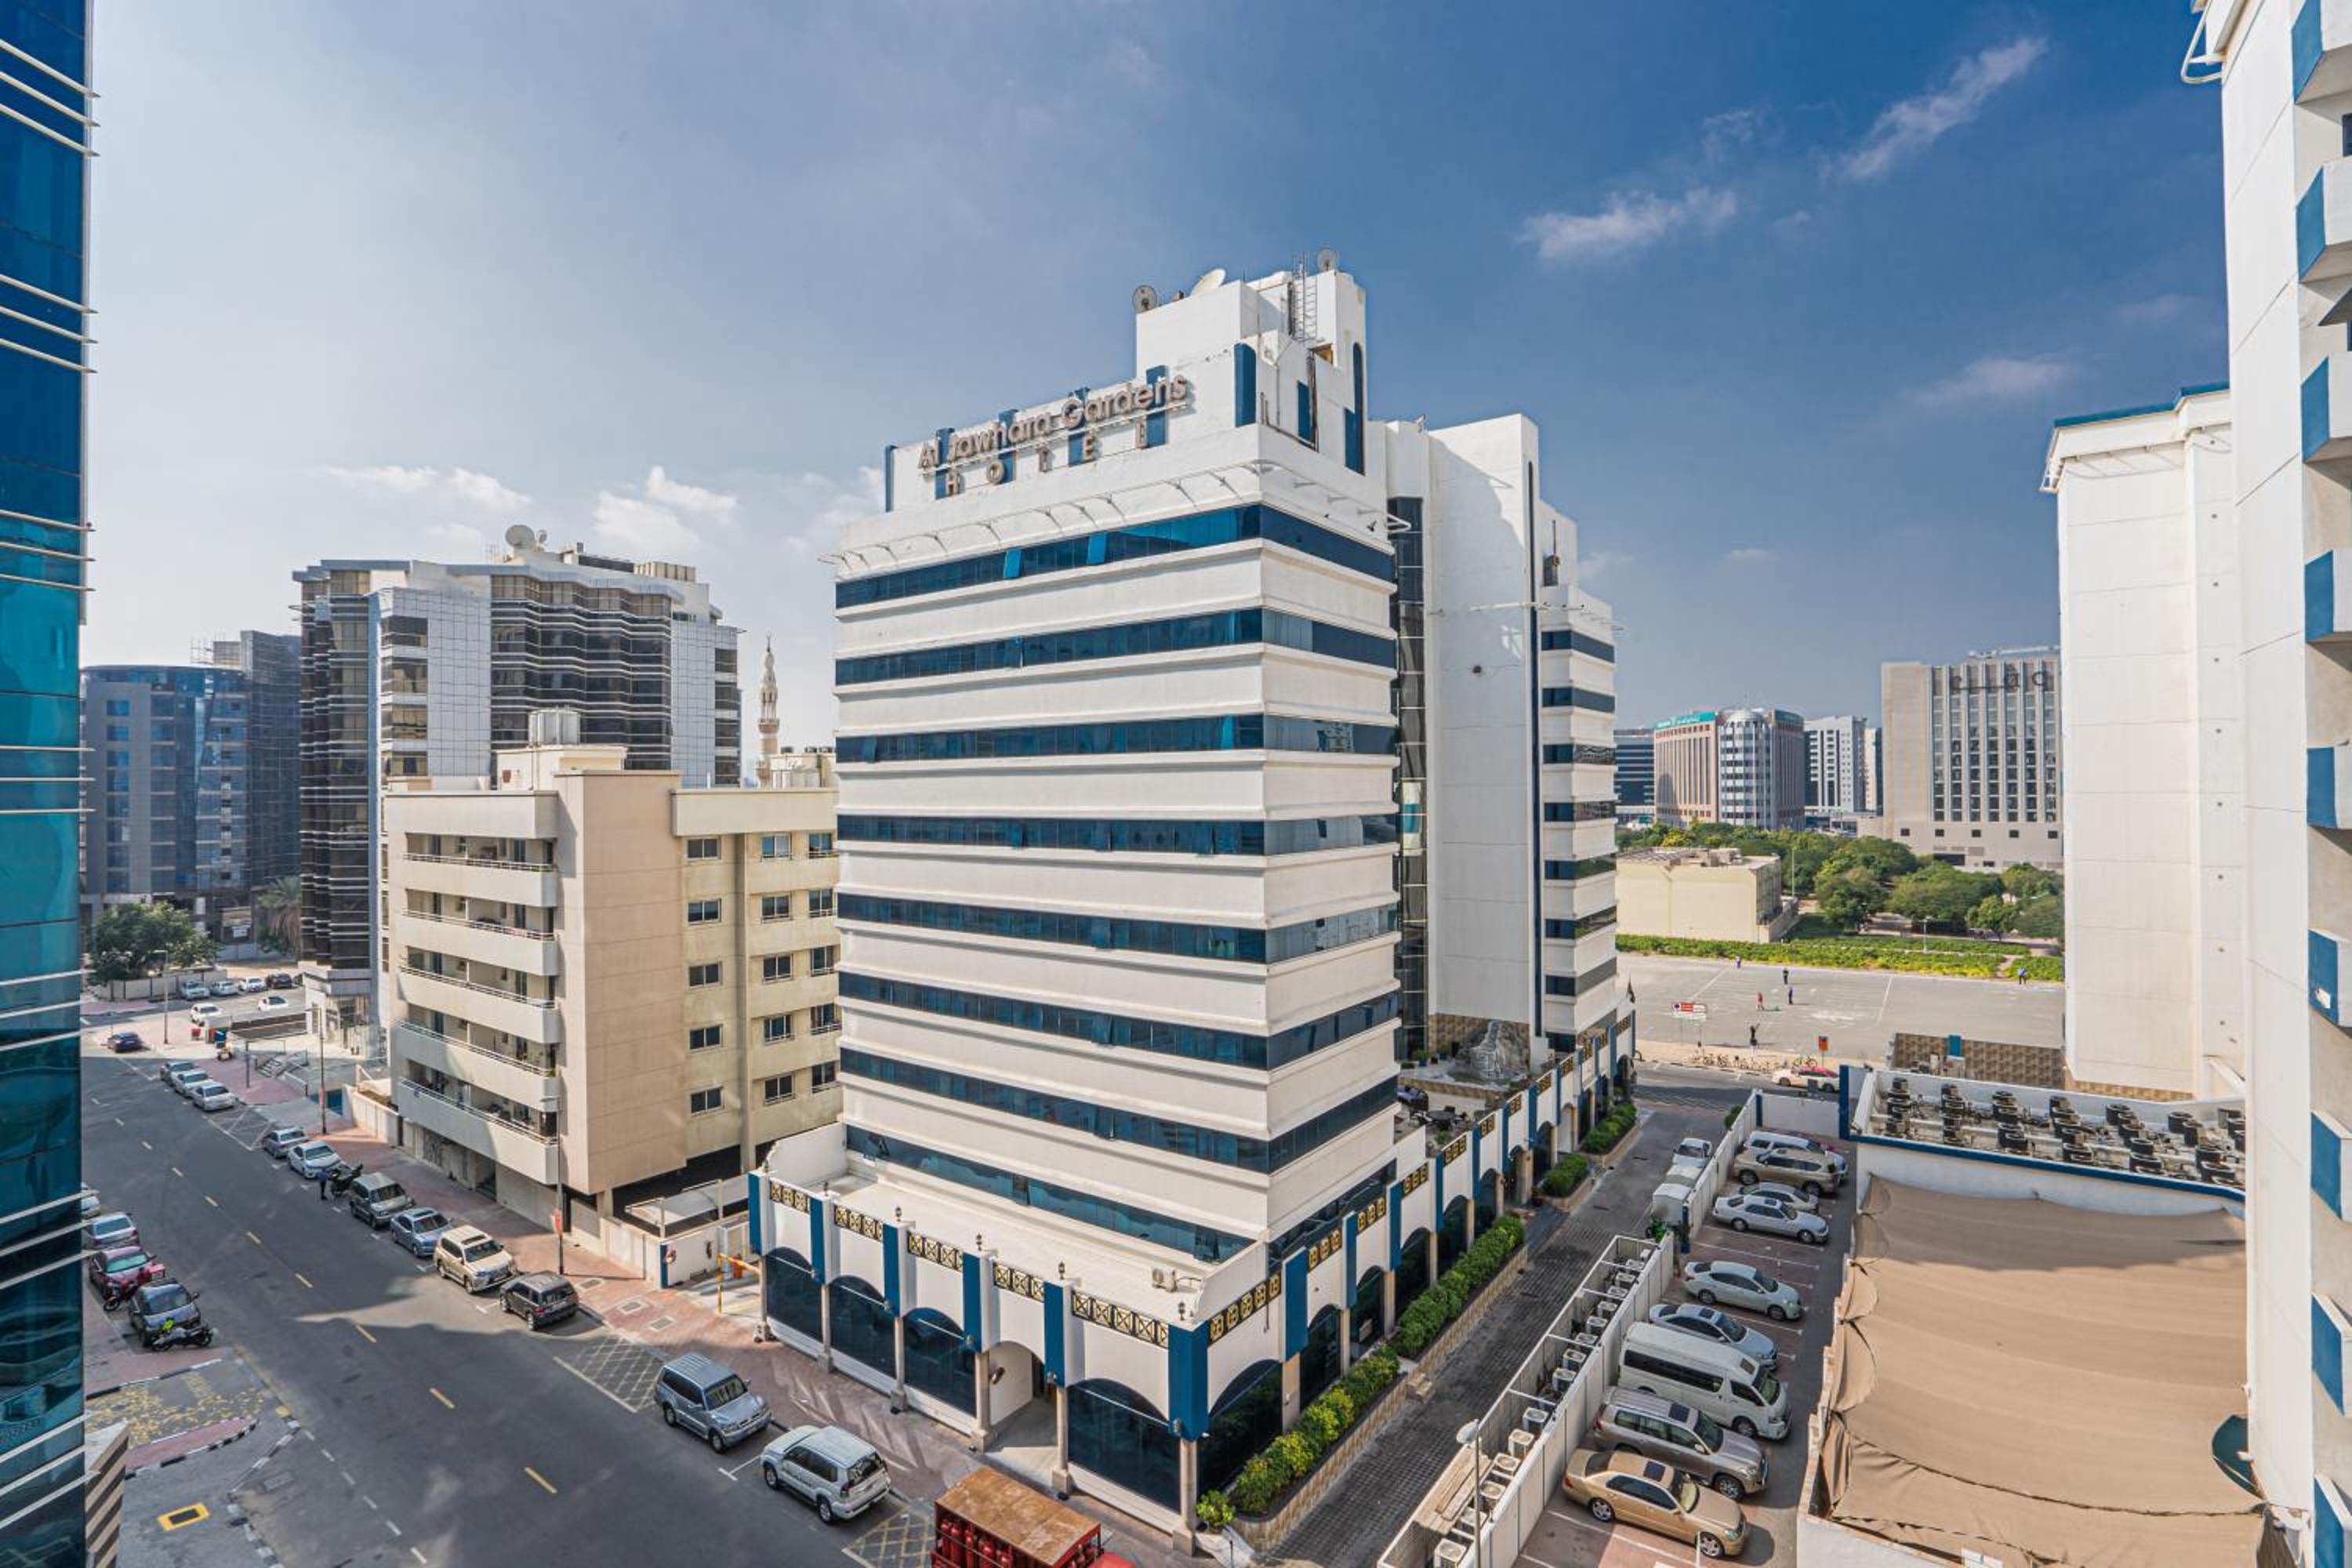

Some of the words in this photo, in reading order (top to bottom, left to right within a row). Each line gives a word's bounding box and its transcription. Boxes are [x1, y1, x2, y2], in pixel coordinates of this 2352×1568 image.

[917, 437, 939, 469] Al
[1061, 374, 1187, 429] Gardens
[946, 417, 1148, 495] HOTEL
